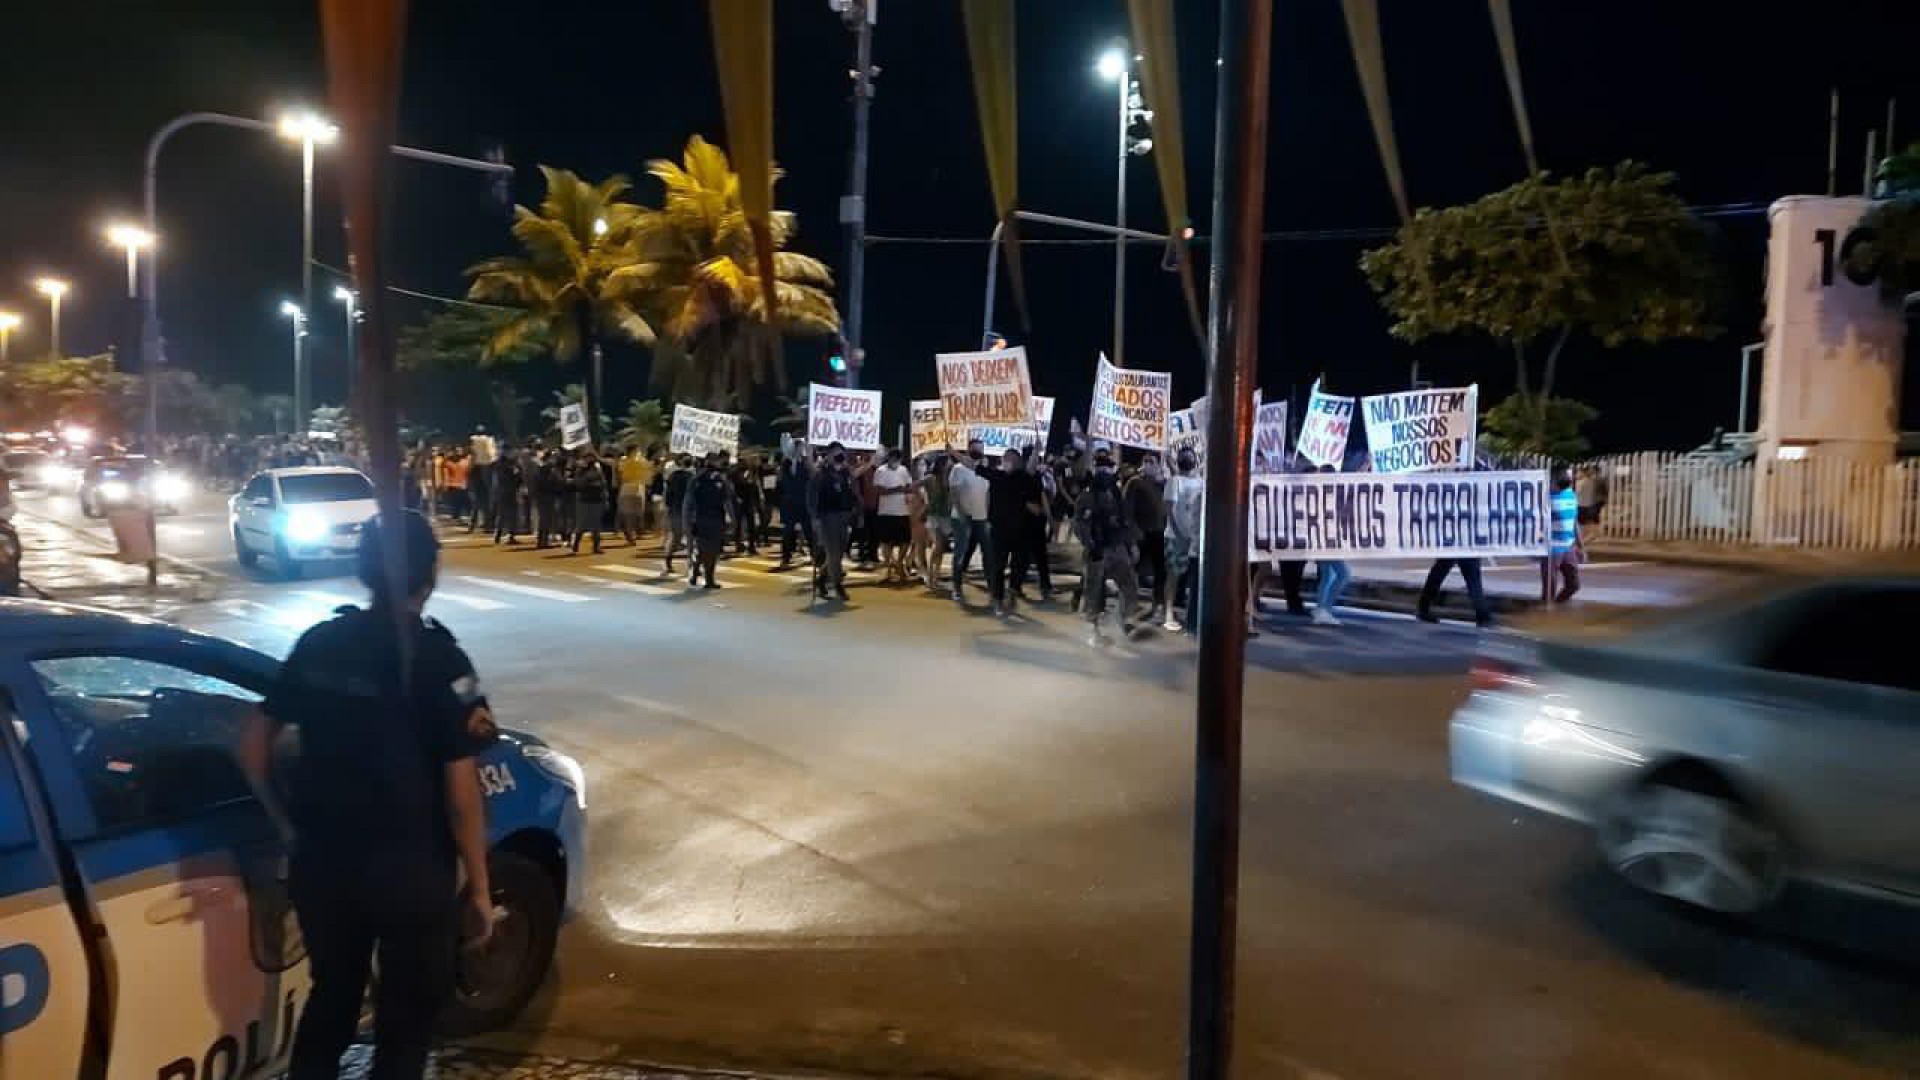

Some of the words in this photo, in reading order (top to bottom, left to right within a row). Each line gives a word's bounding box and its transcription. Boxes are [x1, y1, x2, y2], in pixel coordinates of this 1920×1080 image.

[942, 360, 967, 385] NOS
[970, 356, 1019, 385] DEIXEM
[1369, 395, 1400, 425] NÃO
[1403, 391, 1466, 417] MATEM
[1391, 416, 1449, 445] NOSSOS
[1252, 483, 1386, 552] QUEREMOS
[1392, 479, 1545, 547] TRABALHAR!
